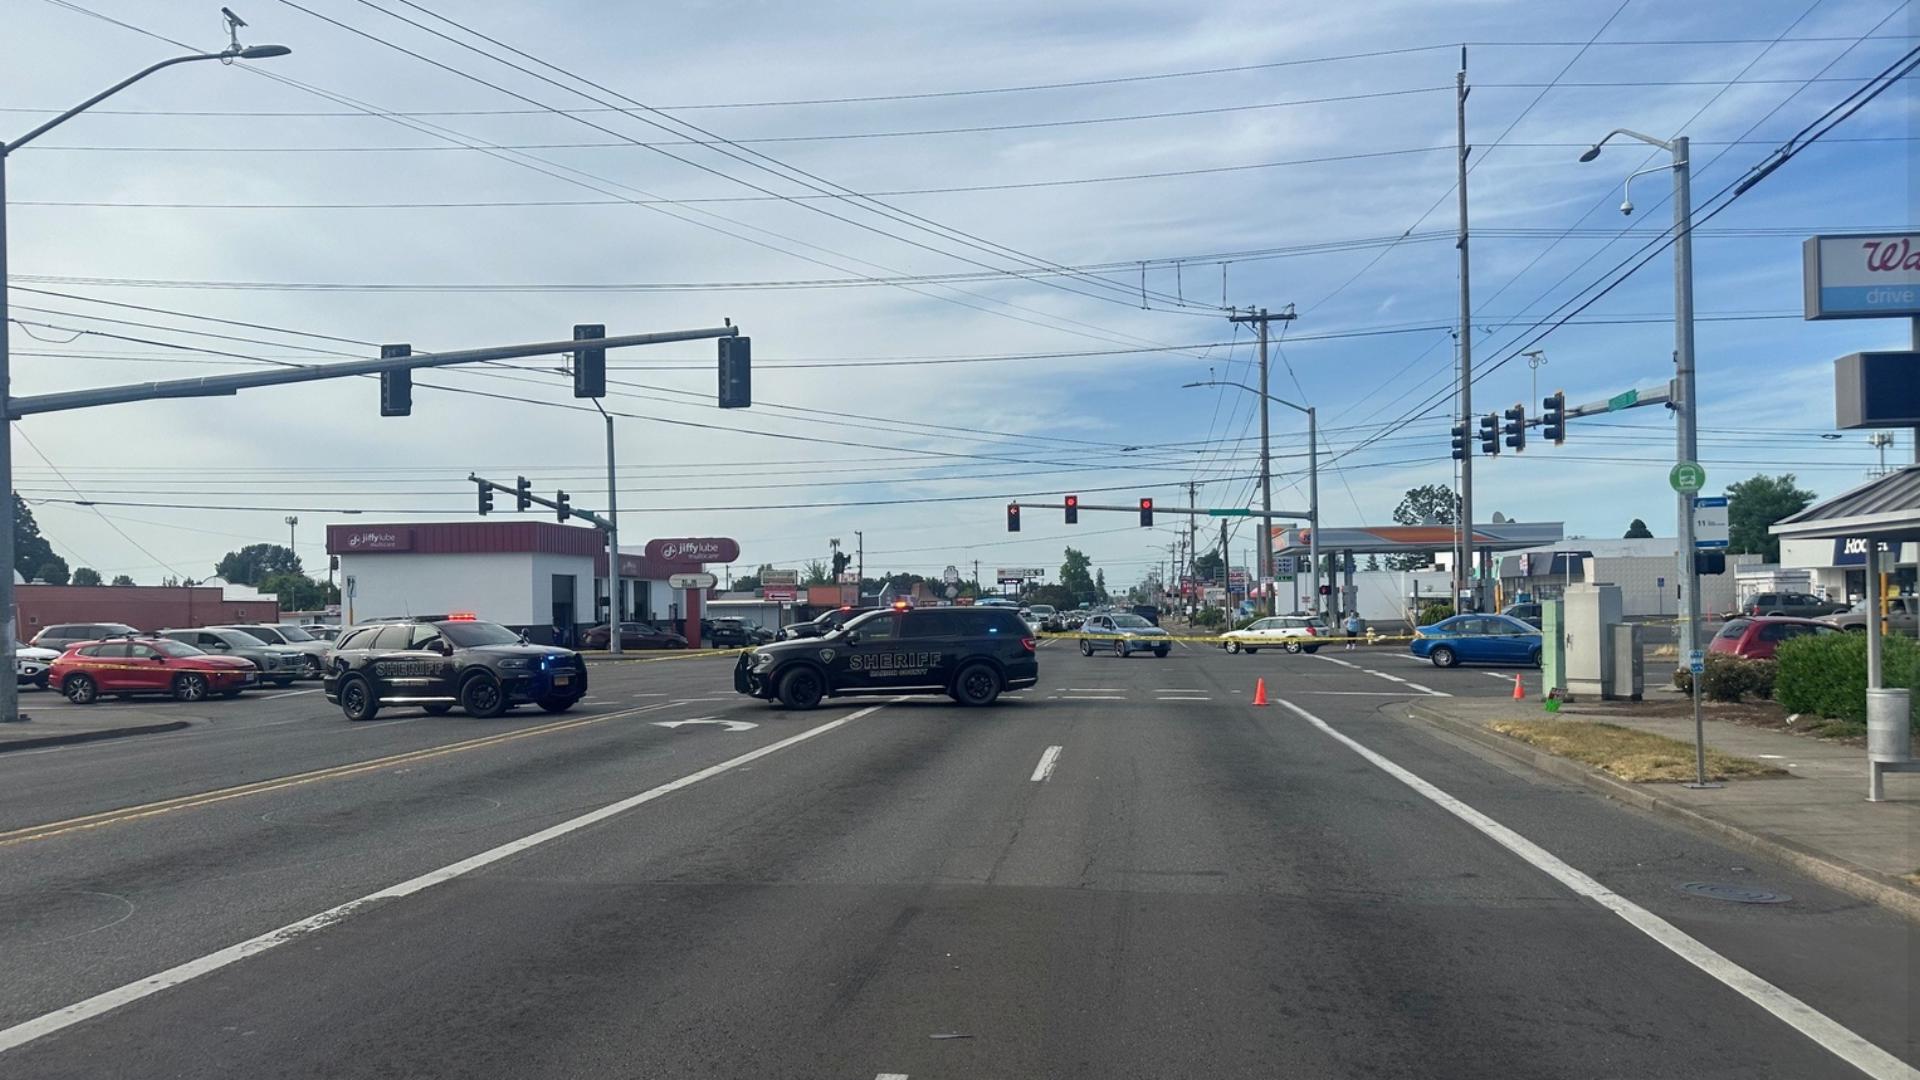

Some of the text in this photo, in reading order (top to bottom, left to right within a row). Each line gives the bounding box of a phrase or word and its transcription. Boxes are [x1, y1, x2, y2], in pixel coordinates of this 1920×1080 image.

[1866, 288, 1915, 304] drive
[1697, 519, 1706, 528] 11
[375, 661, 445, 676] SHERIFF
[849, 652, 942, 670] SHERIFF
